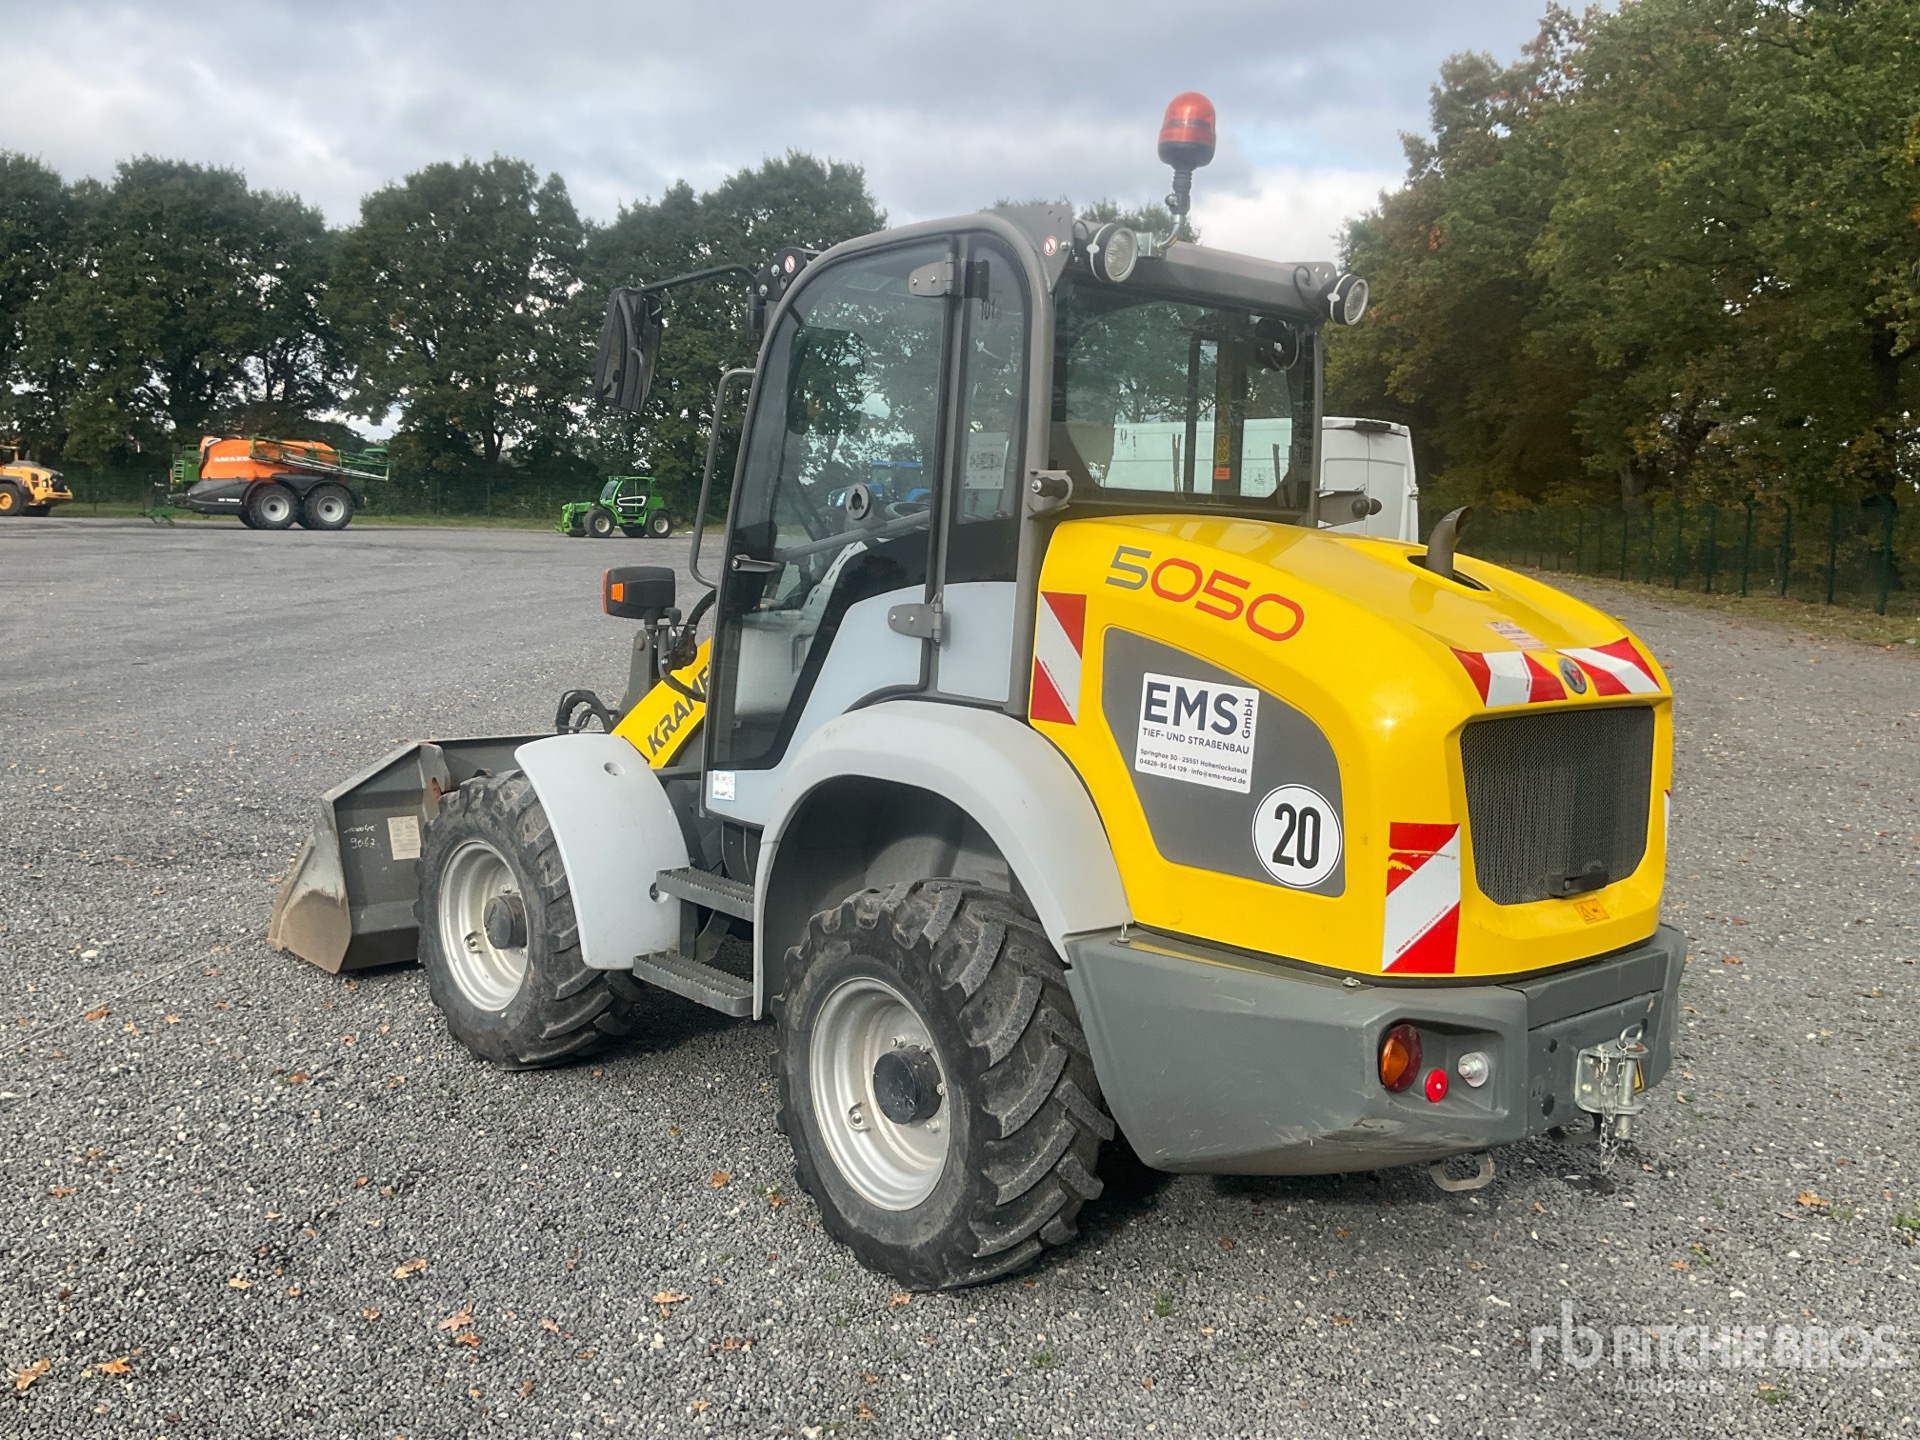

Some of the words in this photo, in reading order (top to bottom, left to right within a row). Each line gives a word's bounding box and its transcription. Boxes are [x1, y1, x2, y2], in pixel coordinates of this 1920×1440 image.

[1105, 545, 1304, 641] 5050
[1144, 681, 1239, 736] EMS
[1241, 698, 1254, 739] GmbH
[1142, 727, 1165, 738] TIEF-
[1166, 731, 1186, 743] UND
[1187, 735, 1250, 755] STRAßENBAU
[1168, 762, 1176, 770] 04
[1177, 764, 1188, 773] 129
[1169, 753, 1178, 761] 30
[1182, 756, 1199, 766] 25551
[1200, 759, 1248, 775] Hohenlockstedt
[1271, 802, 1322, 870] 20
